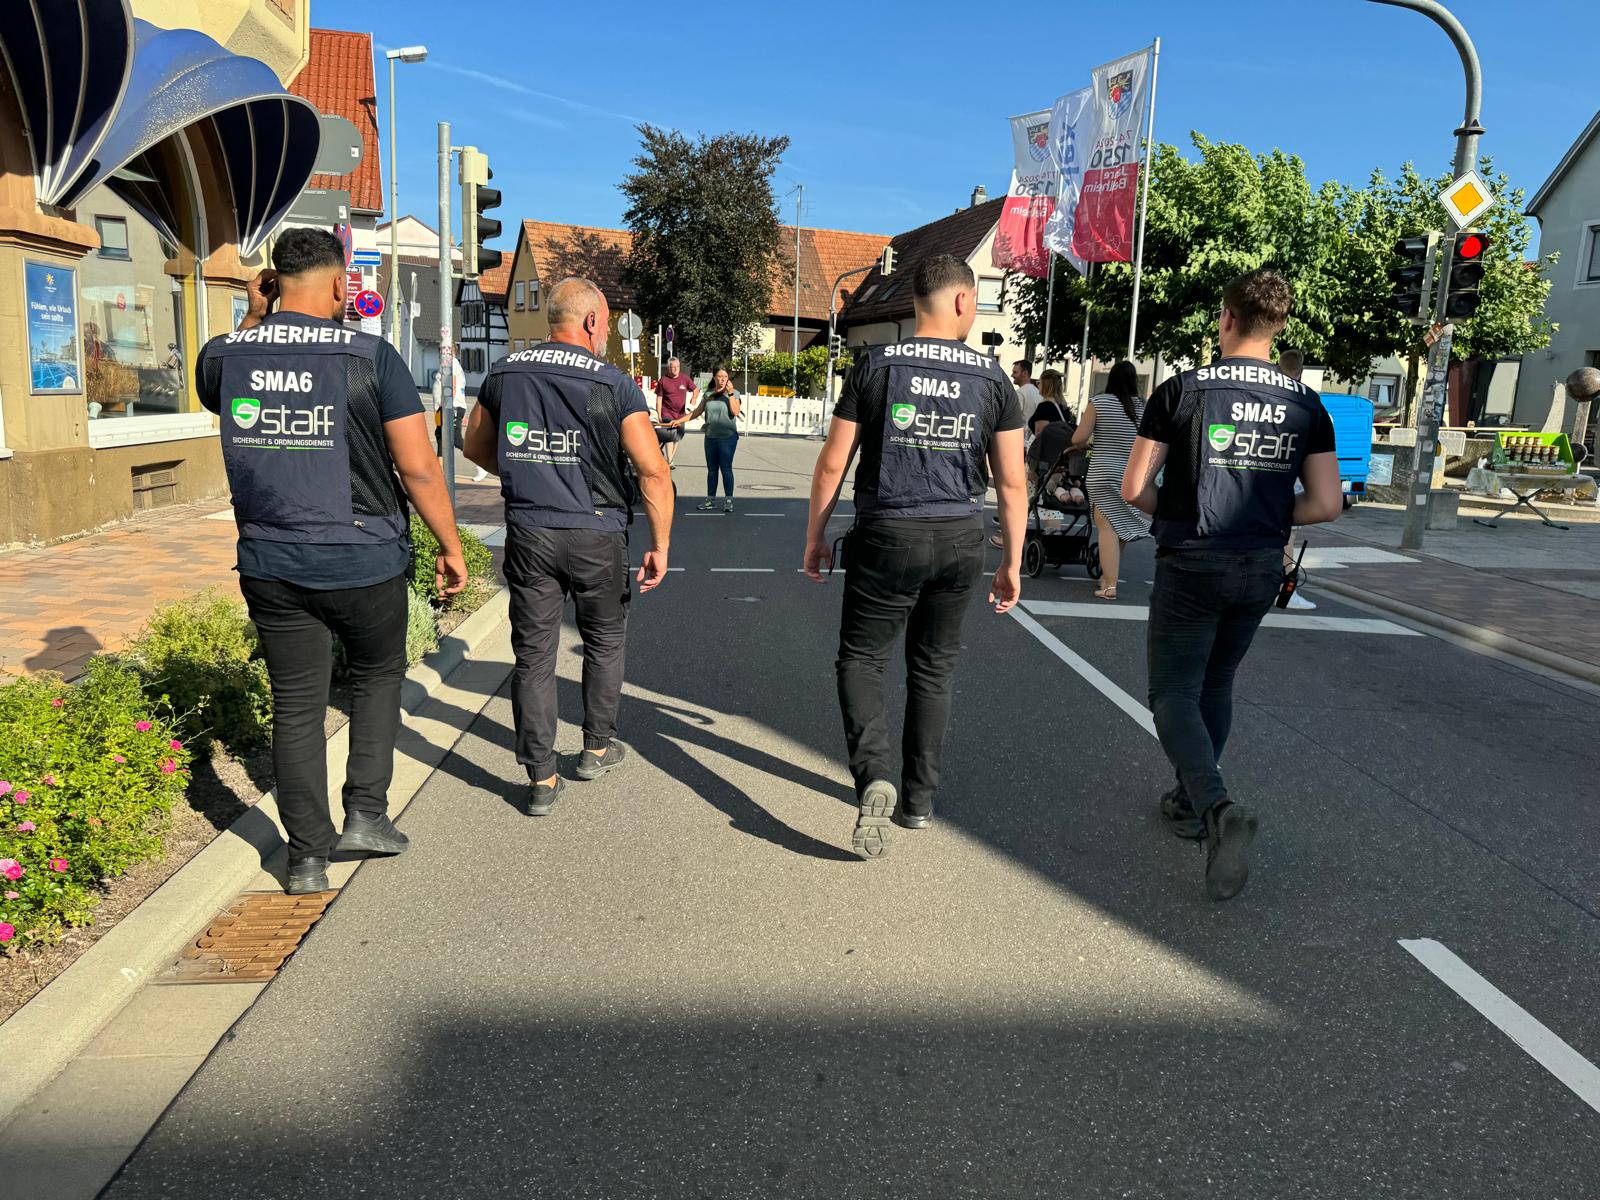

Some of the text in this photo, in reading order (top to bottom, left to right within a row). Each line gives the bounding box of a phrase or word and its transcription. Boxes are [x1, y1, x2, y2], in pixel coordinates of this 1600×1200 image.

[225, 324, 356, 344] SICHERHEIT
[506, 350, 604, 372] SICHERHEIT
[884, 343, 992, 369] SICHERHEIT
[250, 370, 312, 393] SMA6
[910, 376, 961, 400] SMA3
[1196, 366, 1307, 396] SICHERHEIT
[260, 405, 334, 436] staff
[1231, 402, 1287, 424] SMA5
[914, 410, 976, 440] staff
[232, 436, 266, 445] SICHERHEIT
[274, 438, 334, 448] ORDNUNGSDIENSTE
[528, 428, 582, 454] staff
[890, 436, 918, 444] SICHERHEIT
[1234, 430, 1298, 460] staff
[538, 454, 581, 463] ORDNNGSDIENSTE
[1208, 458, 1238, 466] SICHERHEIT
